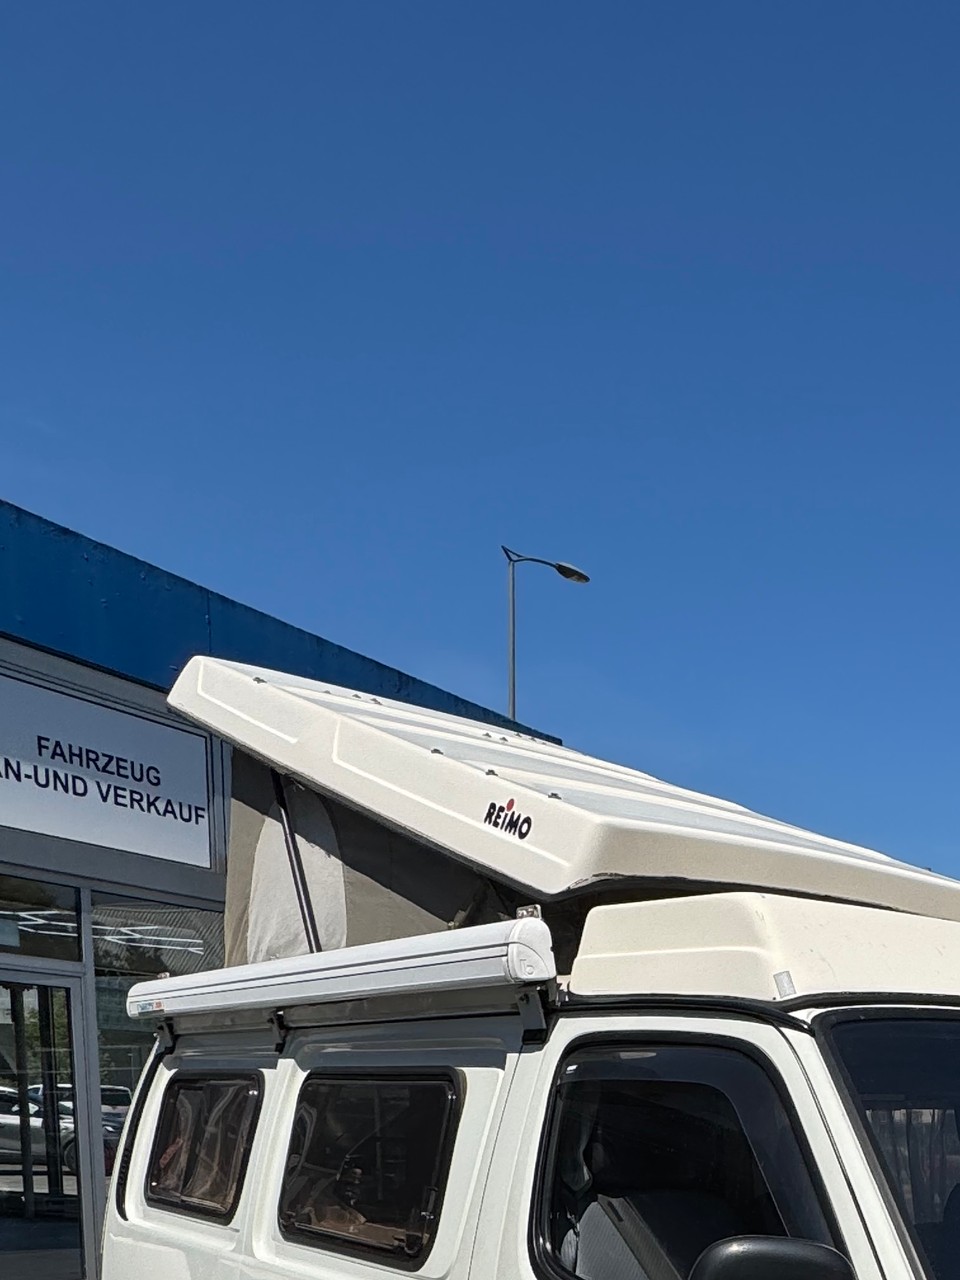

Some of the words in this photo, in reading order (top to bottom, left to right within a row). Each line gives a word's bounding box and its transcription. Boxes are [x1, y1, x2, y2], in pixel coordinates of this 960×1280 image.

[0, 757, 88, 797] N-UND
[95, 780, 206, 825] VERKAUF
[36, 735, 162, 787] FAHRZEUG
